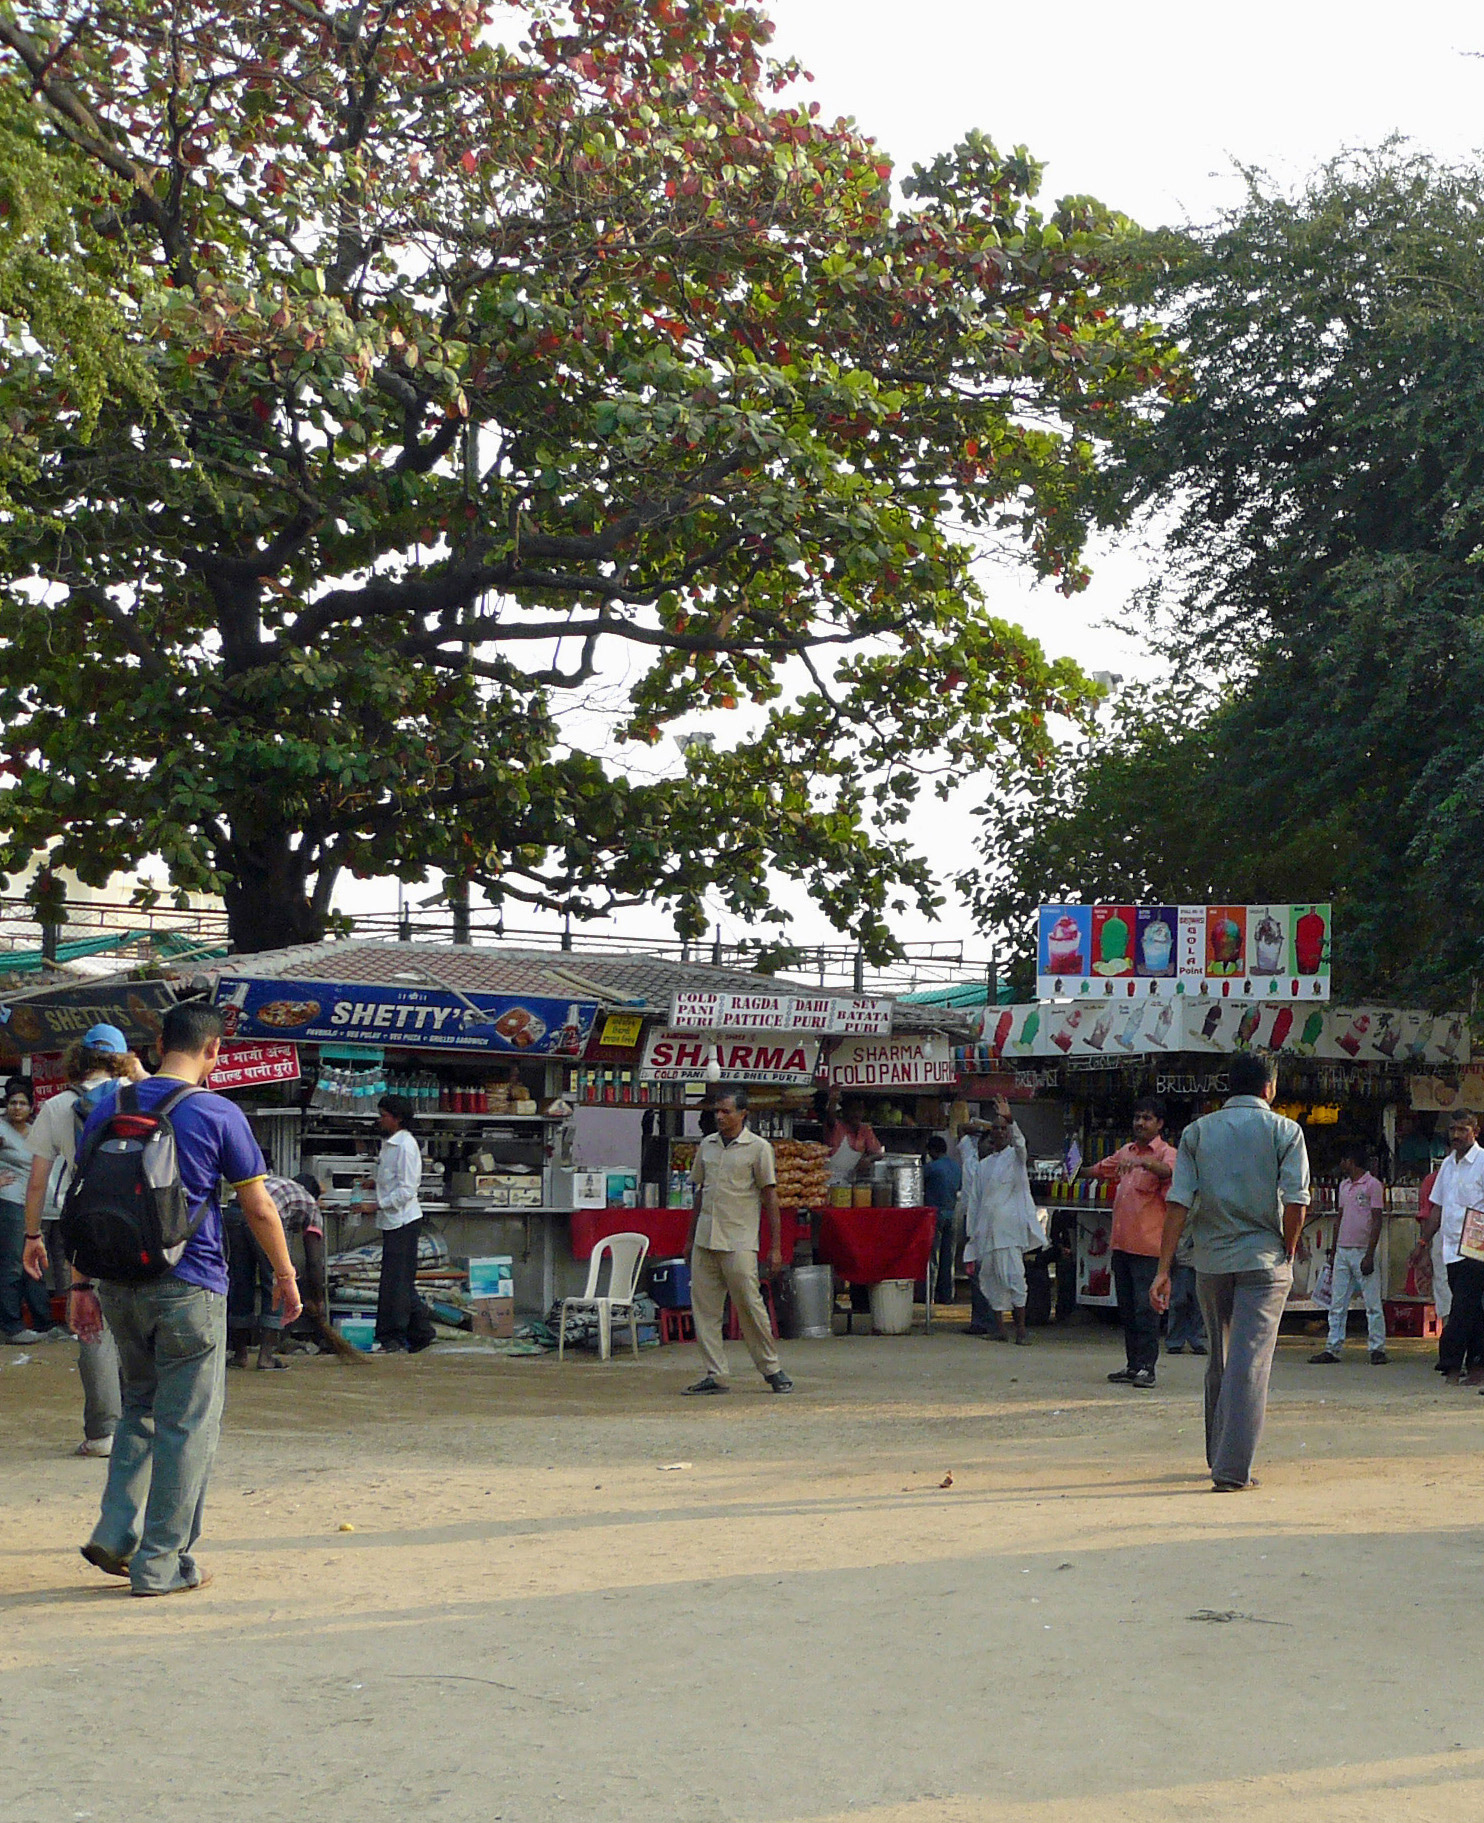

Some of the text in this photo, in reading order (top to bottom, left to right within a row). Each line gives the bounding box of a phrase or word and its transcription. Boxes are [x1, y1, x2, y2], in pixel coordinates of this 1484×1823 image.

[1179, 966, 1203, 975] Point
[677, 993, 718, 1004] COLD
[731, 996, 779, 1011] RAGDA
[853, 1000, 879, 1009] SEV
[678, 1005, 714, 1016] PANI
[795, 1000, 829, 1012] DAHI
[676, 1017, 713, 1027] PURI
[723, 1013, 783, 1027] PATTICE
[792, 1016, 827, 1028] PURI
[837, 1011, 889, 1022] BATATA
[844, 1022, 879, 1033] PURI
[650, 1043, 807, 1072] SHARMA
[852, 1045, 924, 1063] SHARMA
[244, 1062, 271, 1078] पानी
[273, 1059, 293, 1078] पुरी
[833, 1064, 876, 1085] COLD
[879, 1062, 920, 1084] PANI
[653, 1070, 678, 1079] COLD
[681, 1071, 704, 1079] PANI
[743, 1072, 768, 1081] BHEL
[772, 1073, 798, 1082] PURI
